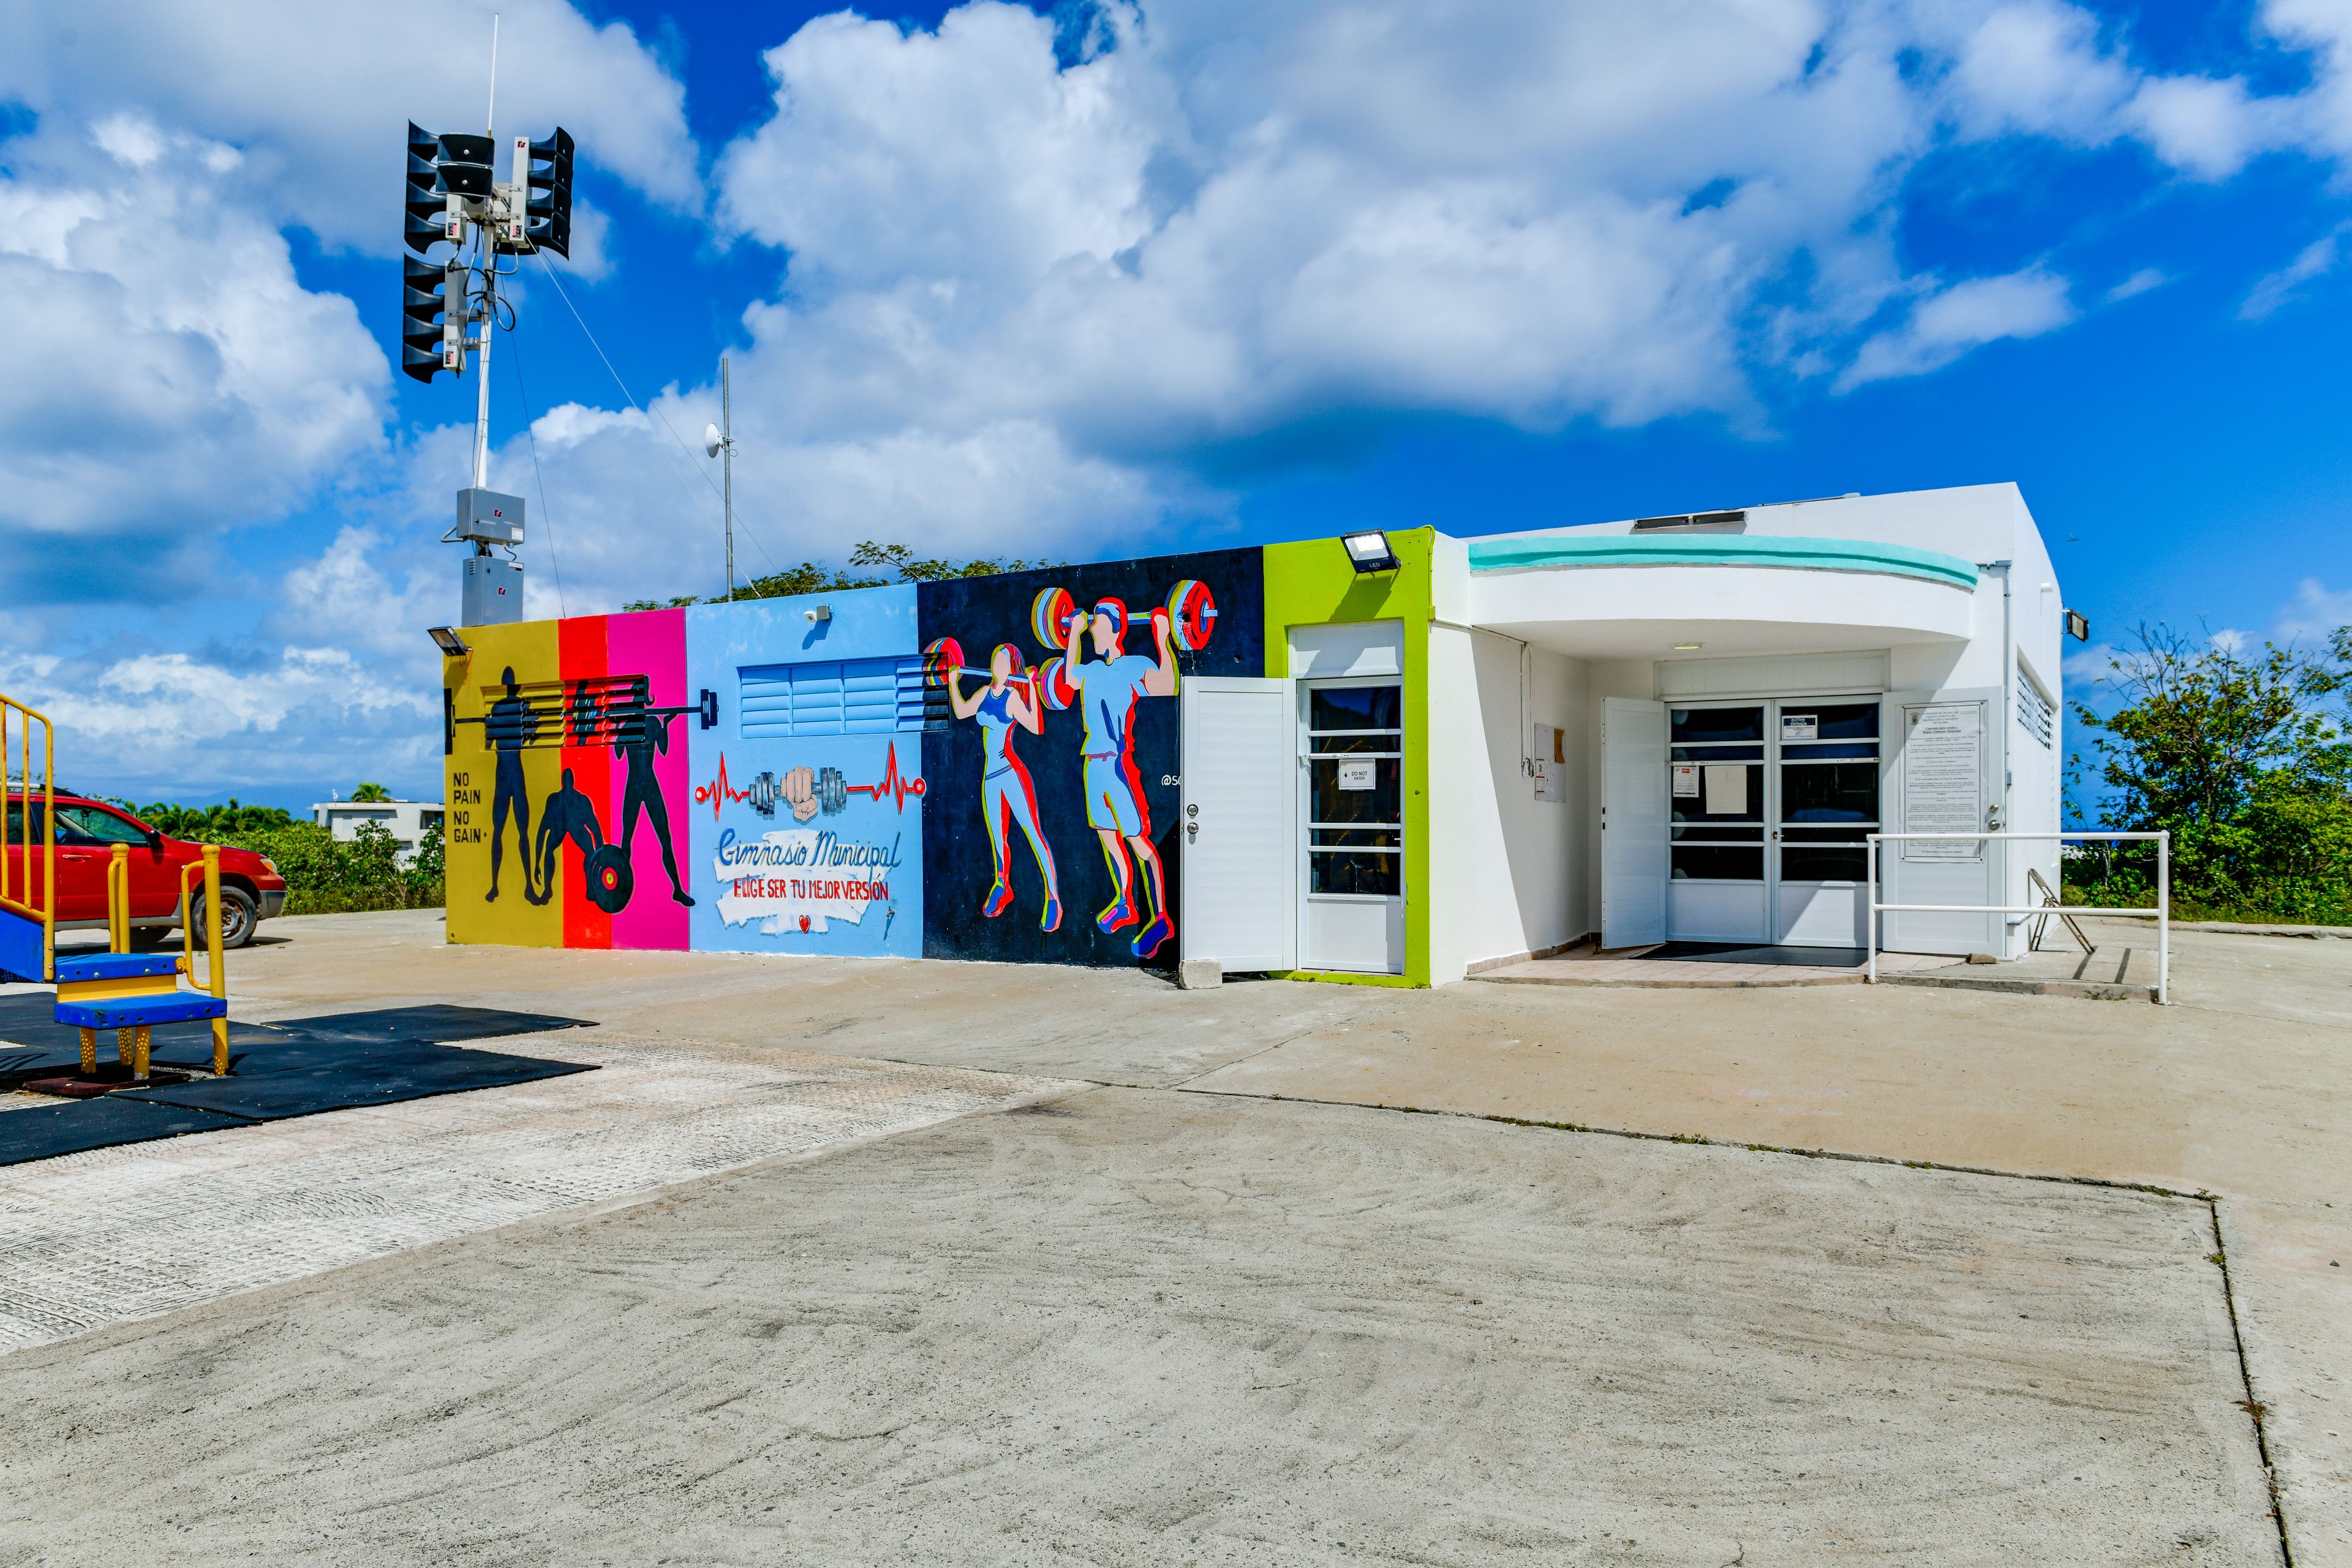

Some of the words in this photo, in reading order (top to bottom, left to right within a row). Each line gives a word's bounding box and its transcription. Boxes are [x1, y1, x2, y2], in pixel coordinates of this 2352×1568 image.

[453, 772, 469, 786] NO
[453, 790, 481, 804] PAIN
[454, 811, 470, 825] NO
[454, 828, 481, 843] GAIN
[718, 827, 809, 866] Gimnasio
[810, 830, 902, 887] Municipal
[734, 874, 765, 898] ELIGE
[767, 878, 786, 898] SER
[790, 879, 806, 899] TU
[809, 880, 840, 900] MEJOR
[841, 873, 889, 901] VERSIÓN
